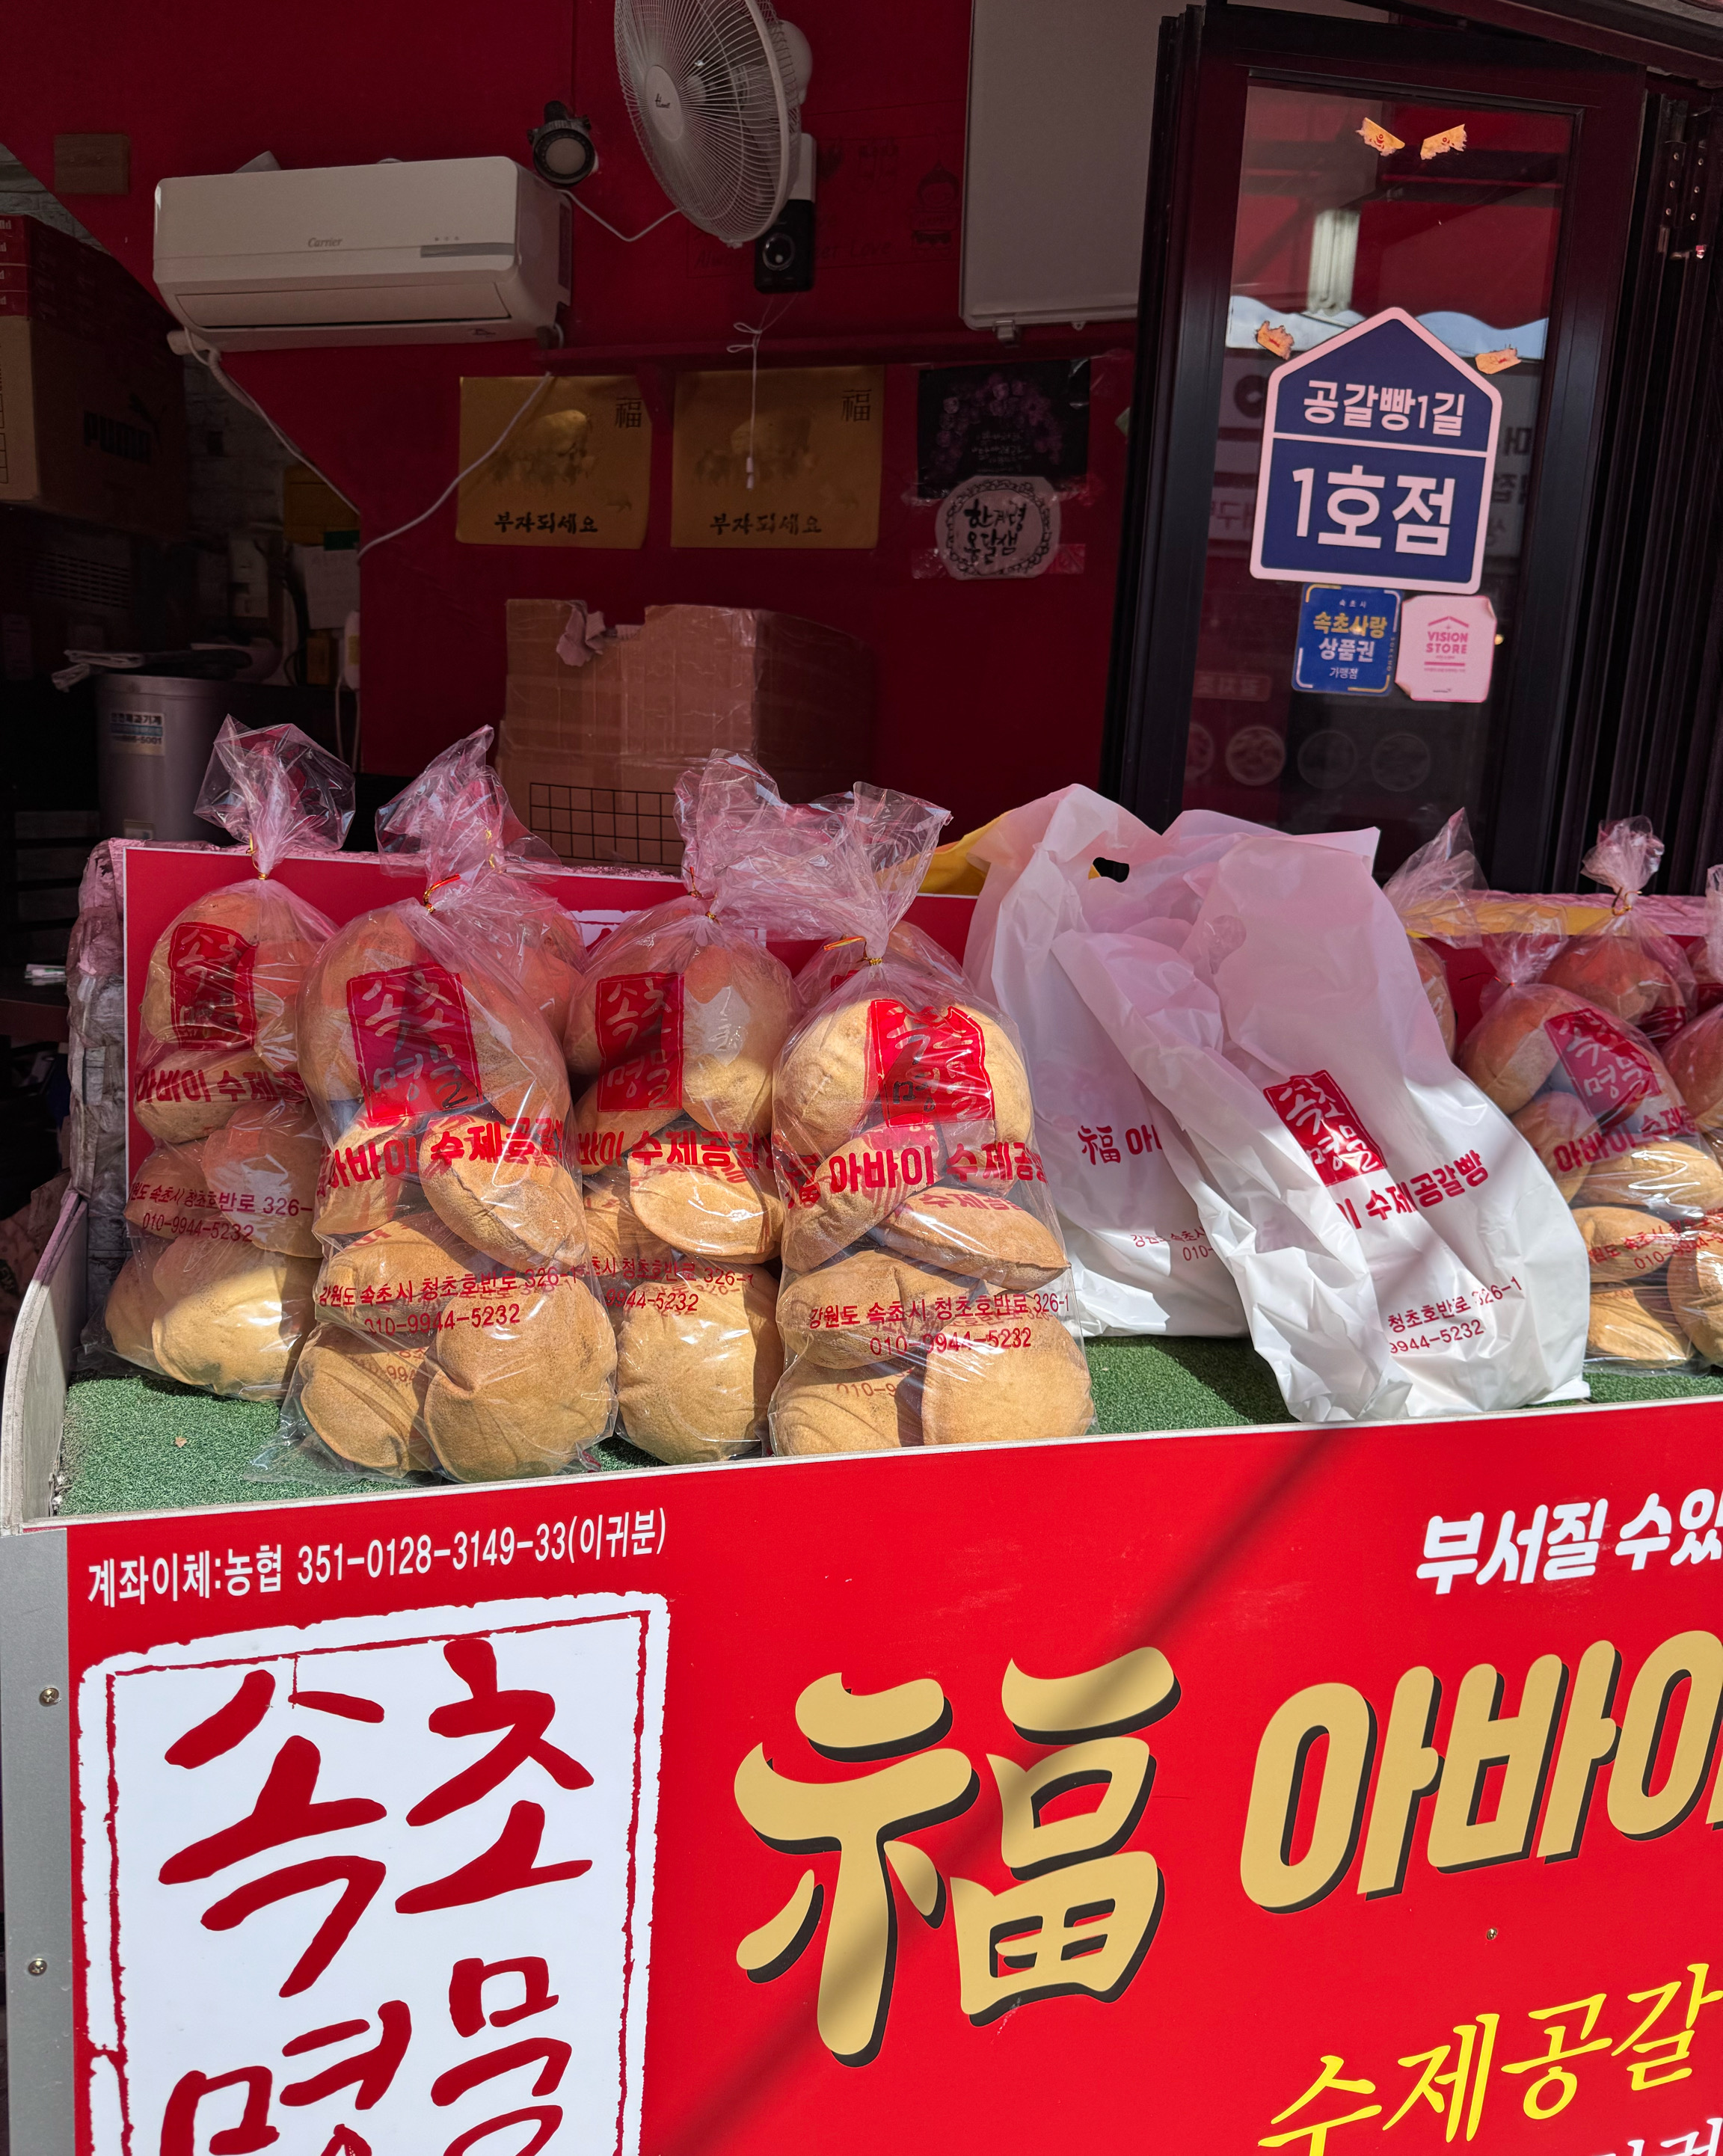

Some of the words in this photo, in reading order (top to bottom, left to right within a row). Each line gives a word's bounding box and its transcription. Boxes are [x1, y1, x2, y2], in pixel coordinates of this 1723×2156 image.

[307, 237, 343, 248] Carrier
[615, 396, 642, 429] 福
[841, 389, 873, 423] 福
[1303, 379, 1466, 437] 공갈빵1길
[494, 512, 599, 535] 부자되세요
[710, 513, 823, 535] 부자되세요
[1292, 464, 1457, 557] 1호점
[1313, 611, 1389, 639] 속초사랑
[1427, 631, 1469, 643] VISION
[1318, 636, 1376, 663] 상품권
[1425, 642, 1468, 654] STORE
[1329, 667, 1360, 680] 가맹점
[1078, 1125, 1121, 1165] 福
[1307, 1124, 1380, 1172] 명물
[1552, 1123, 1636, 1173] 아바이
[829, 1145, 935, 1194] 아바이
[1365, 1149, 1489, 1221] 수제공갈빵
[150, 1185, 185, 1206] 속초시
[185, 1189, 256, 1212] 청초호반로
[142, 1212, 254, 1242] 010-9944-5232
[319, 1285, 357, 1307] 강원도
[360, 1280, 413, 1307] 속초시
[420, 1270, 518, 1302] 청초호반로
[524, 1265, 577, 1289] 326-1
[622, 1258, 697, 1282] 청초호반로
[364, 1303, 520, 1336] 010-9944-5232
[809, 1304, 860, 1330] 강원도
[867, 1300, 927, 1323] 속초시
[934, 1293, 1029, 1321] 청초호반로
[1033, 1292, 1070, 1312] 326-1
[1387, 1295, 1472, 1333] 청초호반로
[870, 1327, 1032, 1356] 010-9944-5232
[87, 1544, 283, 1608] 계좌이체:농협
[298, 1506, 667, 1586] 351-0128-3149-33(이귀분)
[1416, 1498, 1609, 1595] 부서질
[158, 1637, 595, 1998] 속초
[734, 1645, 1182, 2068] 福
[1258, 1962, 1723, 2156] 수제공갈
